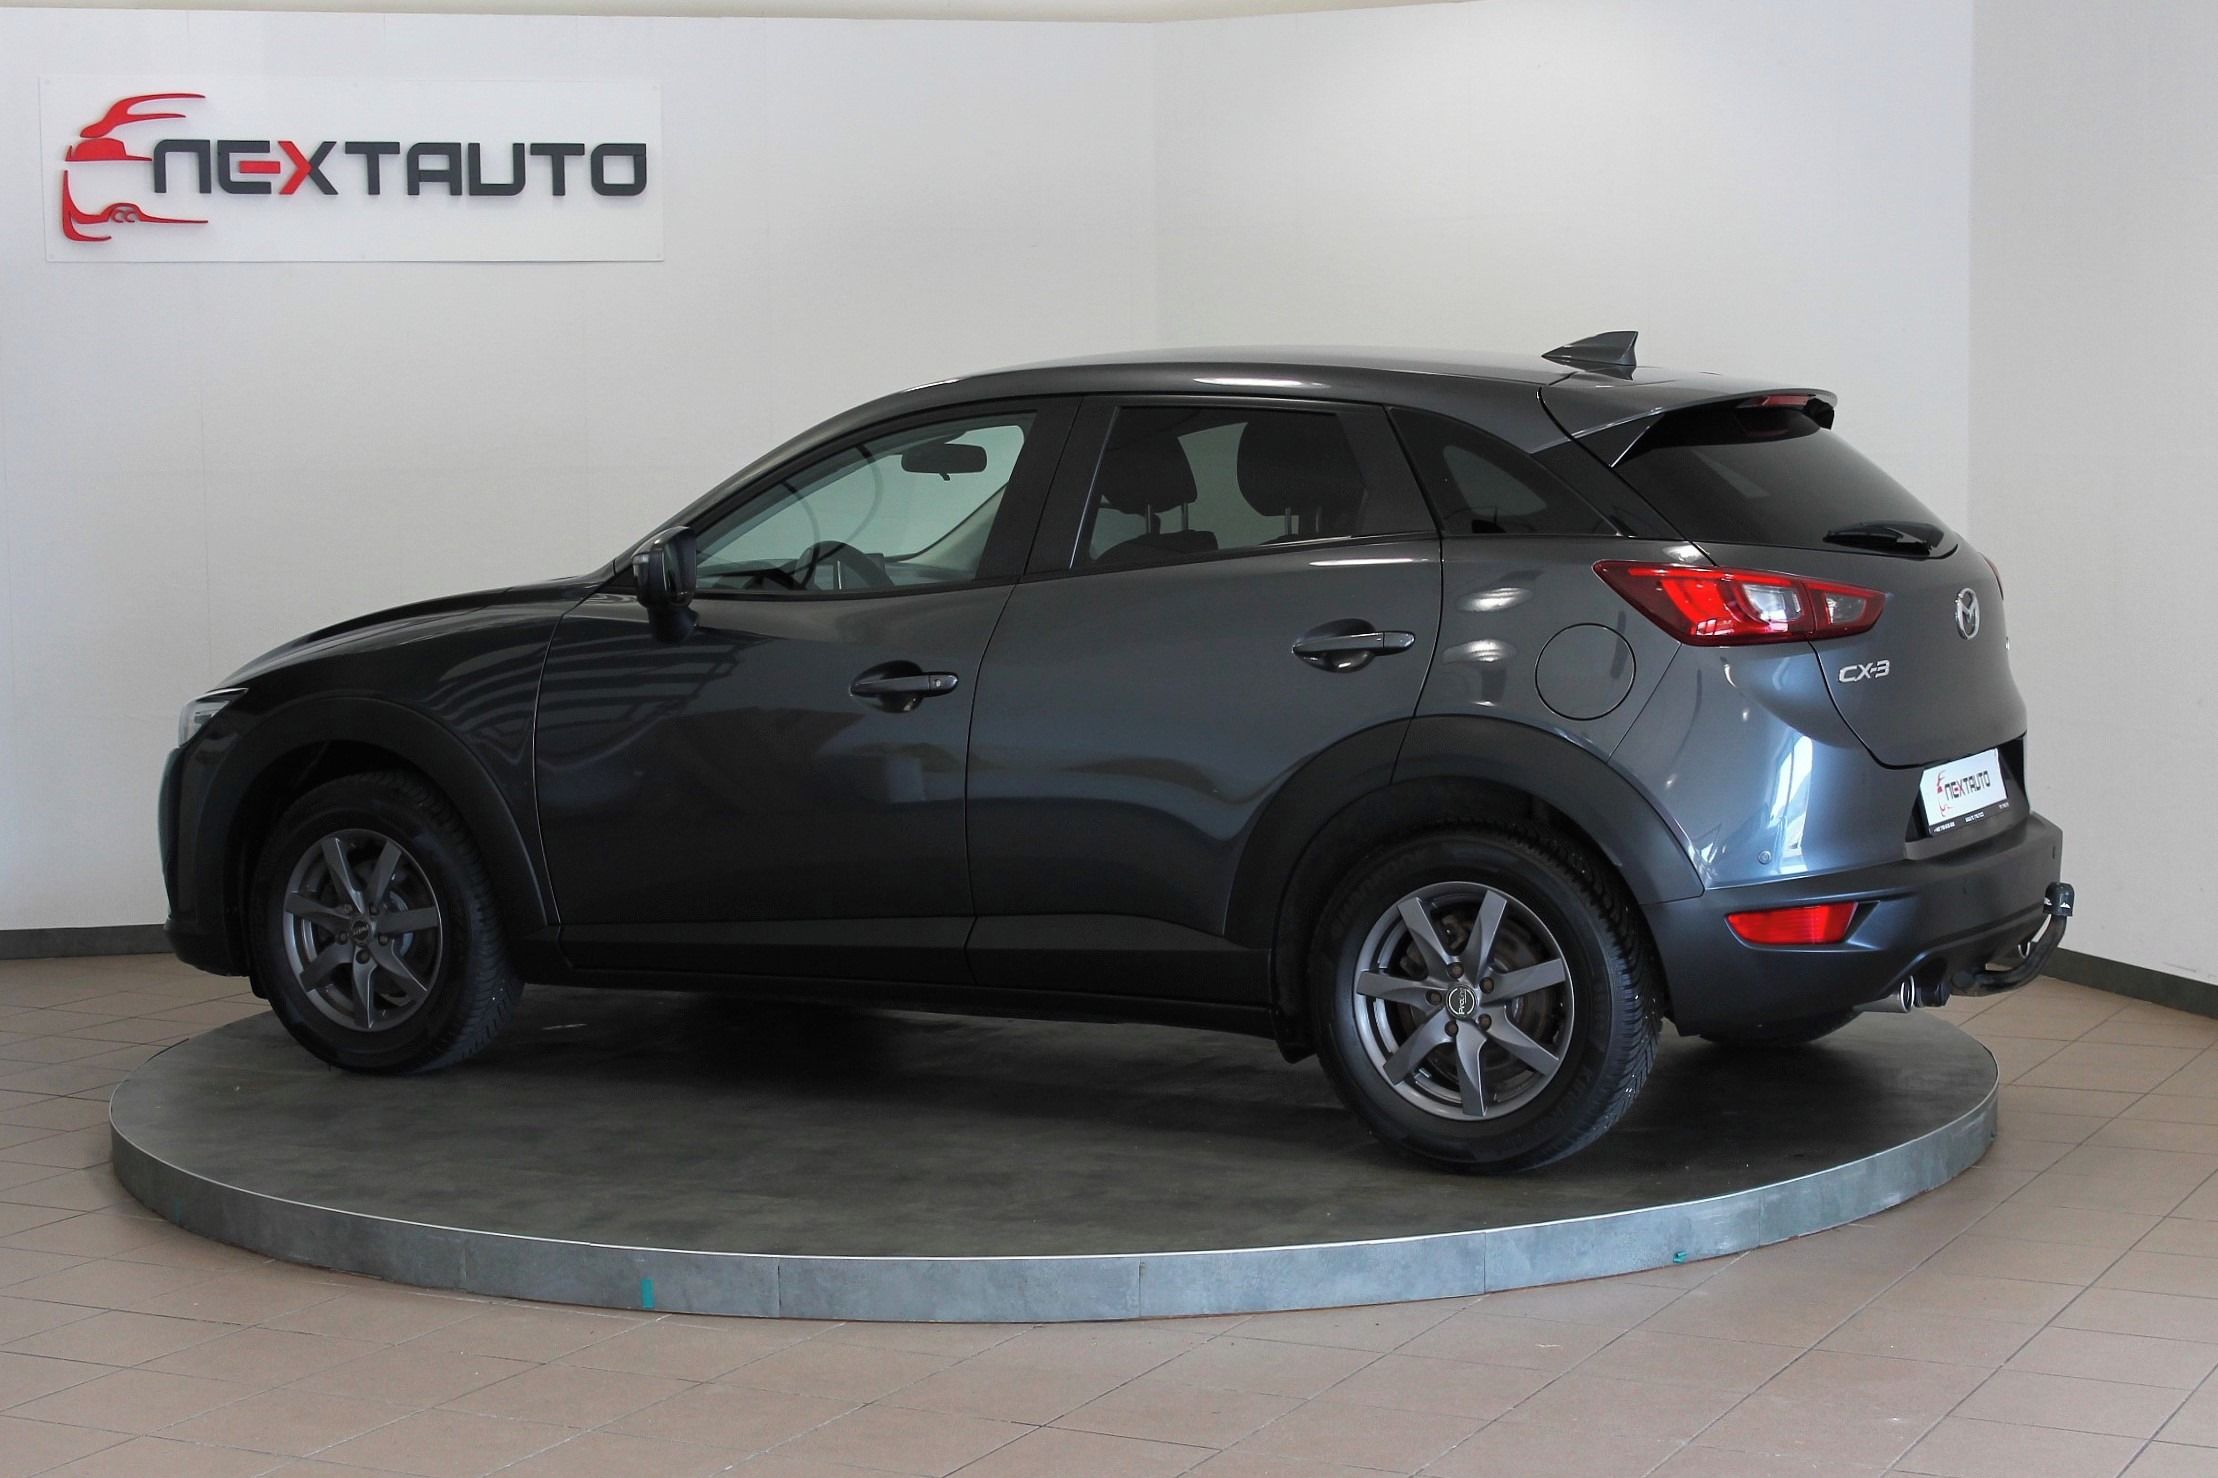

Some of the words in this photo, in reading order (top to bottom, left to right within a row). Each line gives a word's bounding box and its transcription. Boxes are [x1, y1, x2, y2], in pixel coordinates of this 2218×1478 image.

[153, 138, 647, 196] NEXTAUTO
[1838, 659, 1890, 683] CX-3
[1944, 770, 1991, 801] NEXTAUTO
